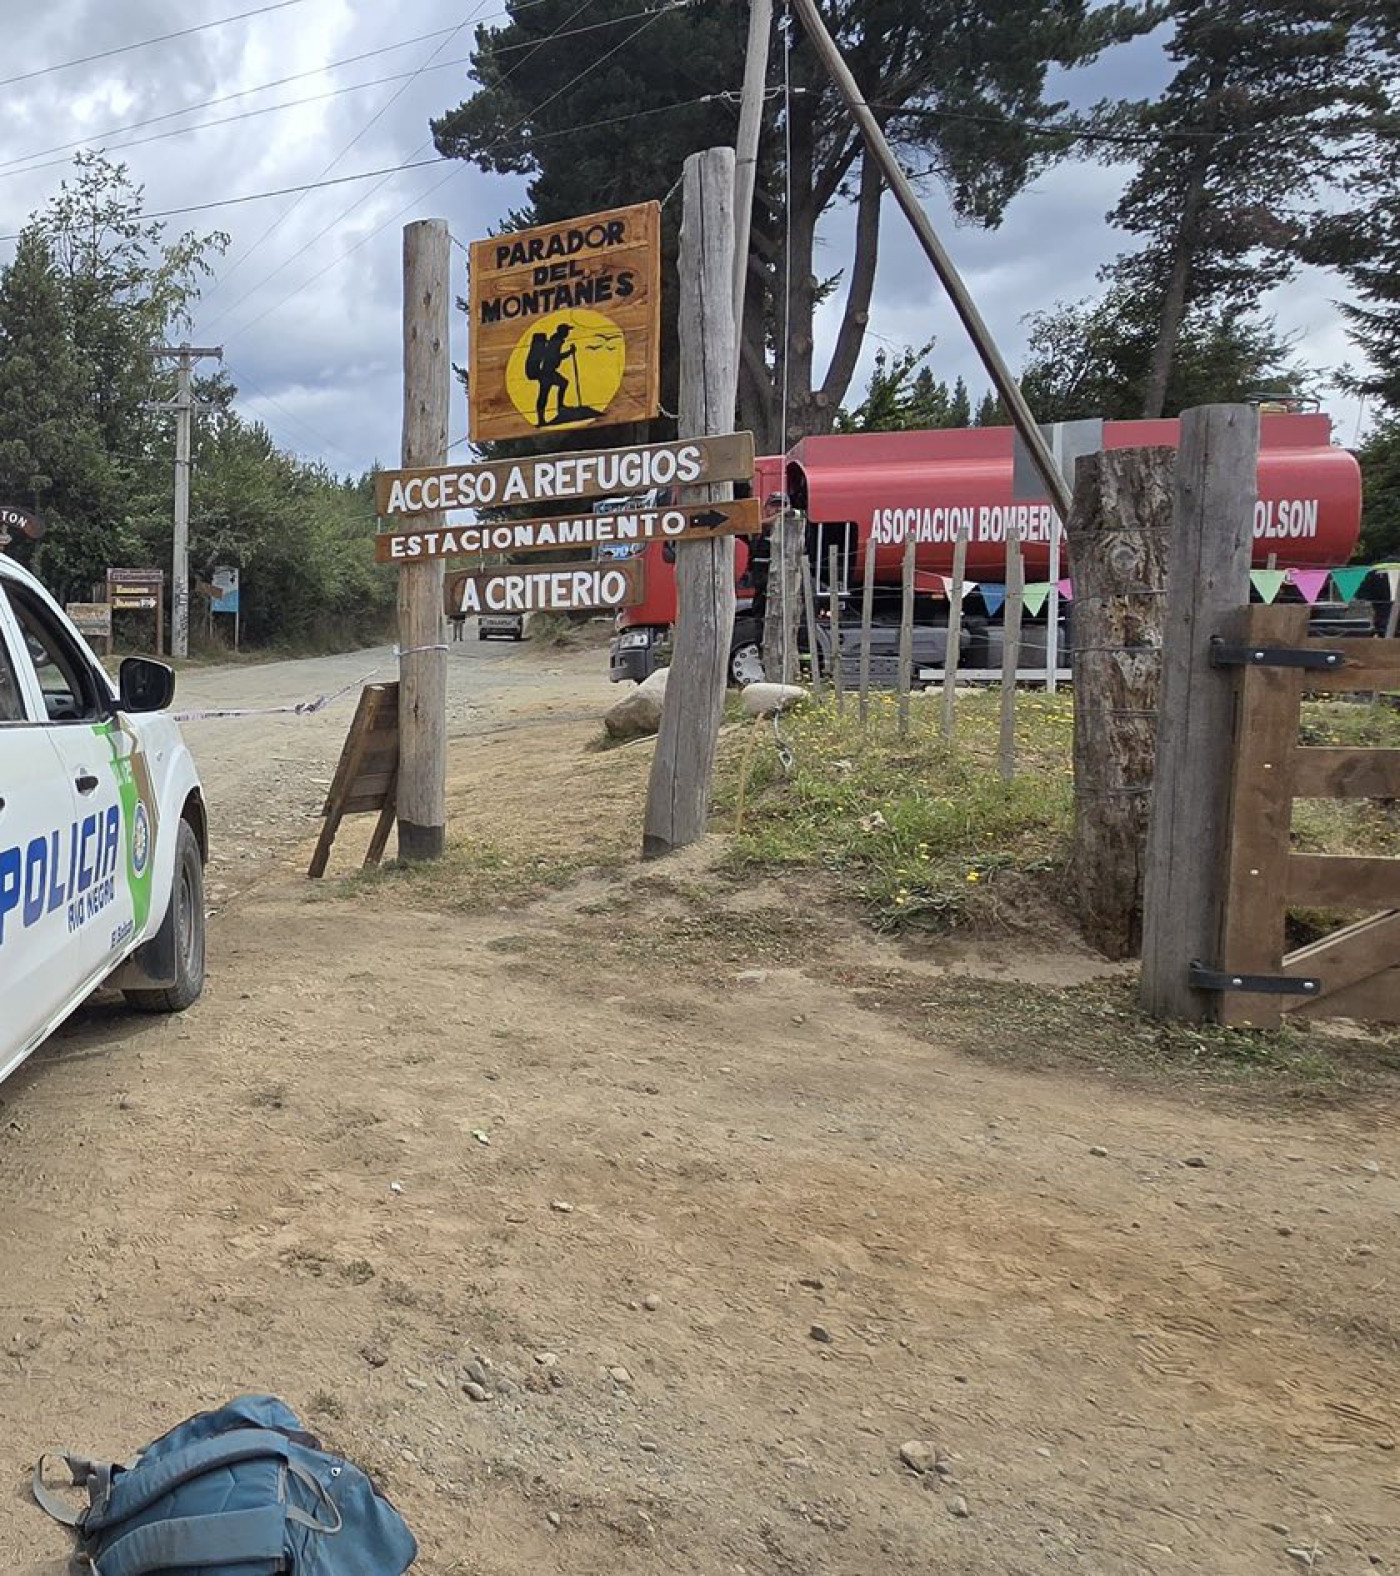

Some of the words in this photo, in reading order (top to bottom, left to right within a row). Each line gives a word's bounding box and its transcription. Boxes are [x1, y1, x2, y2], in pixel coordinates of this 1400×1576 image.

[496, 221, 625, 269] PARADOR
[533, 260, 584, 285] DEL
[387, 472, 496, 514] ACCESO
[503, 466, 528, 501] A
[534, 446, 701, 498] REFUGIOS
[391, 511, 686, 557] ESTACIONAMIENTO
[871, 507, 974, 543] ASOCIACION
[978, 503, 1068, 541] BOMBER
[1253, 499, 1319, 538] OLSON
[460, 578, 480, 612] A
[484, 570, 626, 611] CRITERIO
